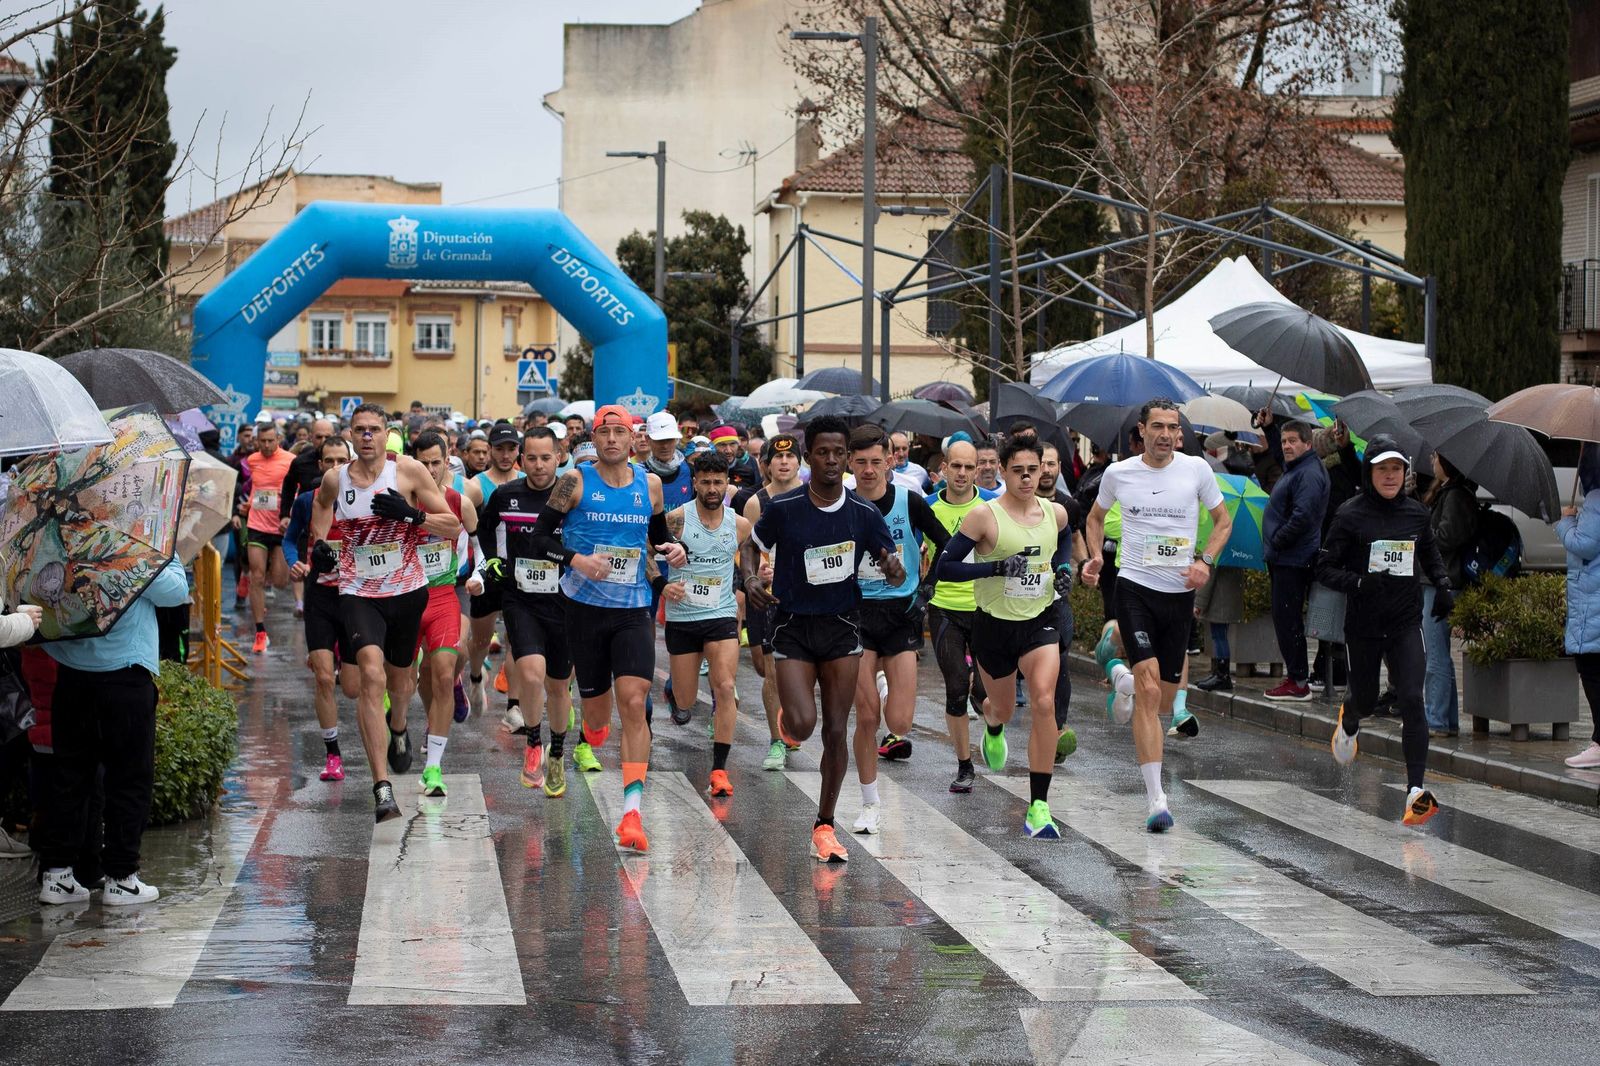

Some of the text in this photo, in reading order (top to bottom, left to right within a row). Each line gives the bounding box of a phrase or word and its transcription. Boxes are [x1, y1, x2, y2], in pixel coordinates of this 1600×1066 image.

[424, 231, 493, 244] Diputación
[422, 249, 492, 261] de Granada
[242, 244, 325, 324] DEPORTES
[551, 247, 634, 325] DEPORTES
[586, 511, 648, 525] TROTASIERRA
[1157, 545, 1178, 557] 552
[1232, 550, 1254, 560] pelayo
[1384, 551, 1403, 562] 504
[368, 554, 386, 566] 101
[424, 552, 441, 564] 123
[608, 557, 627, 570] 382
[821, 555, 843, 570] 190
[526, 569, 546, 581] 369
[1020, 574, 1041, 586] 524
[692, 584, 709, 596] 135
